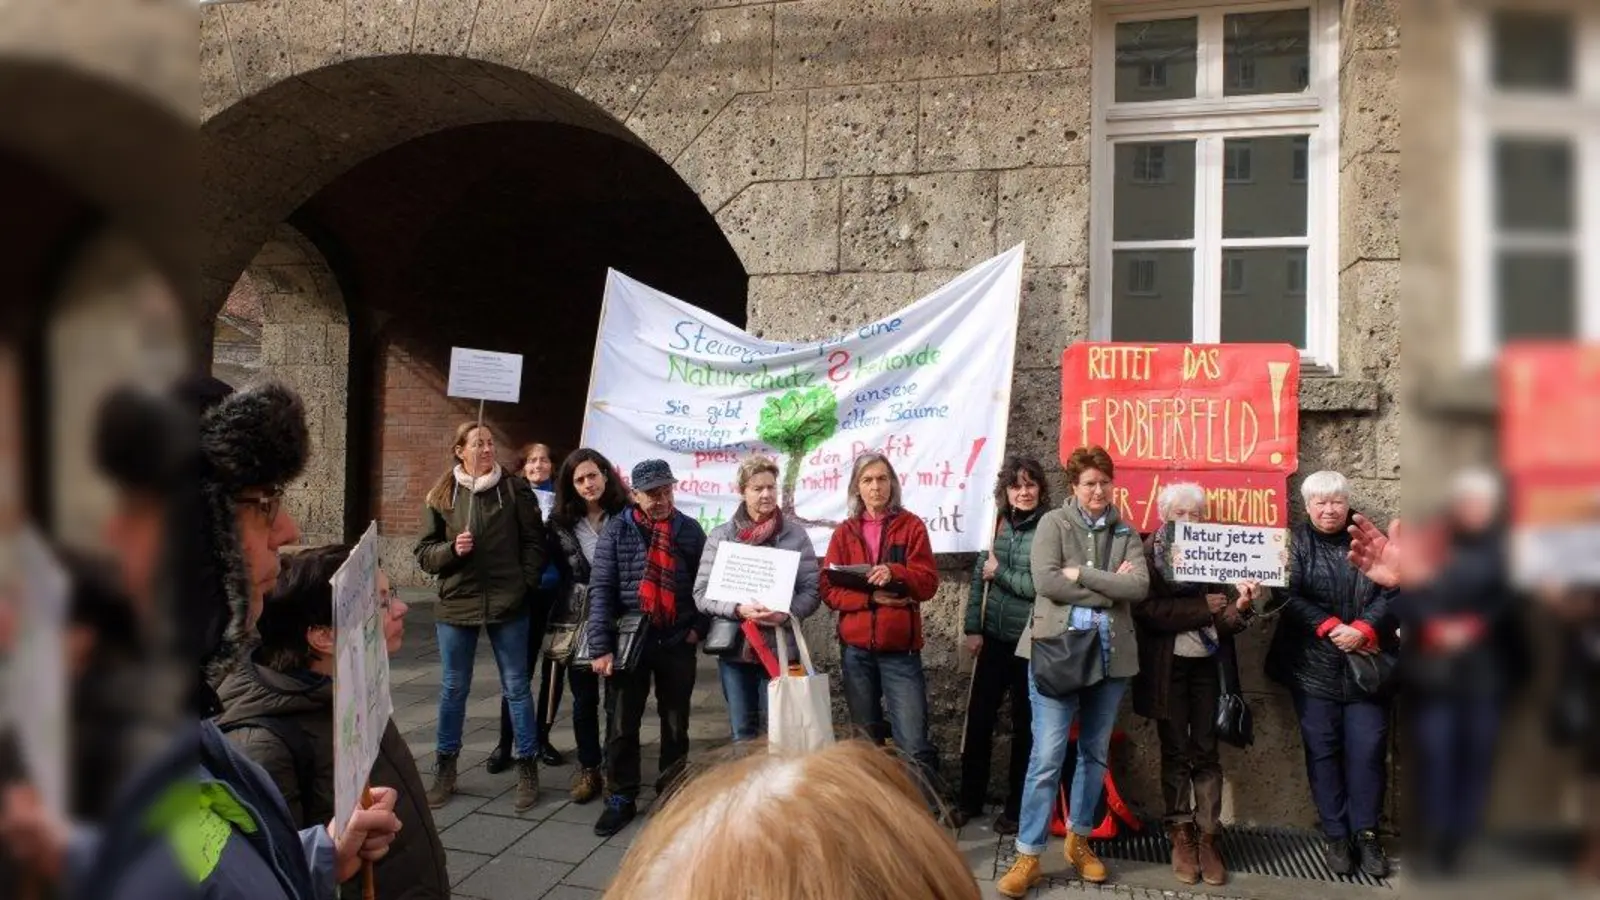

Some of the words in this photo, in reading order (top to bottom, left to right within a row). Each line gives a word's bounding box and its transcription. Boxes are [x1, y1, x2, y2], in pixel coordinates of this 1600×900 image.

[1088, 347, 1159, 380] RETTET
[1183, 347, 1221, 381] DAS
[706, 400, 743, 425] gibt
[855, 382, 918, 404] unsere
[694, 449, 739, 468] preis
[809, 447, 841, 467] den
[801, 467, 843, 491] nicht
[1183, 525, 1222, 543] Natur
[1227, 530, 1264, 548] jetzt
[1184, 545, 1247, 562] schützen
[1176, 564, 1207, 577] nicht
